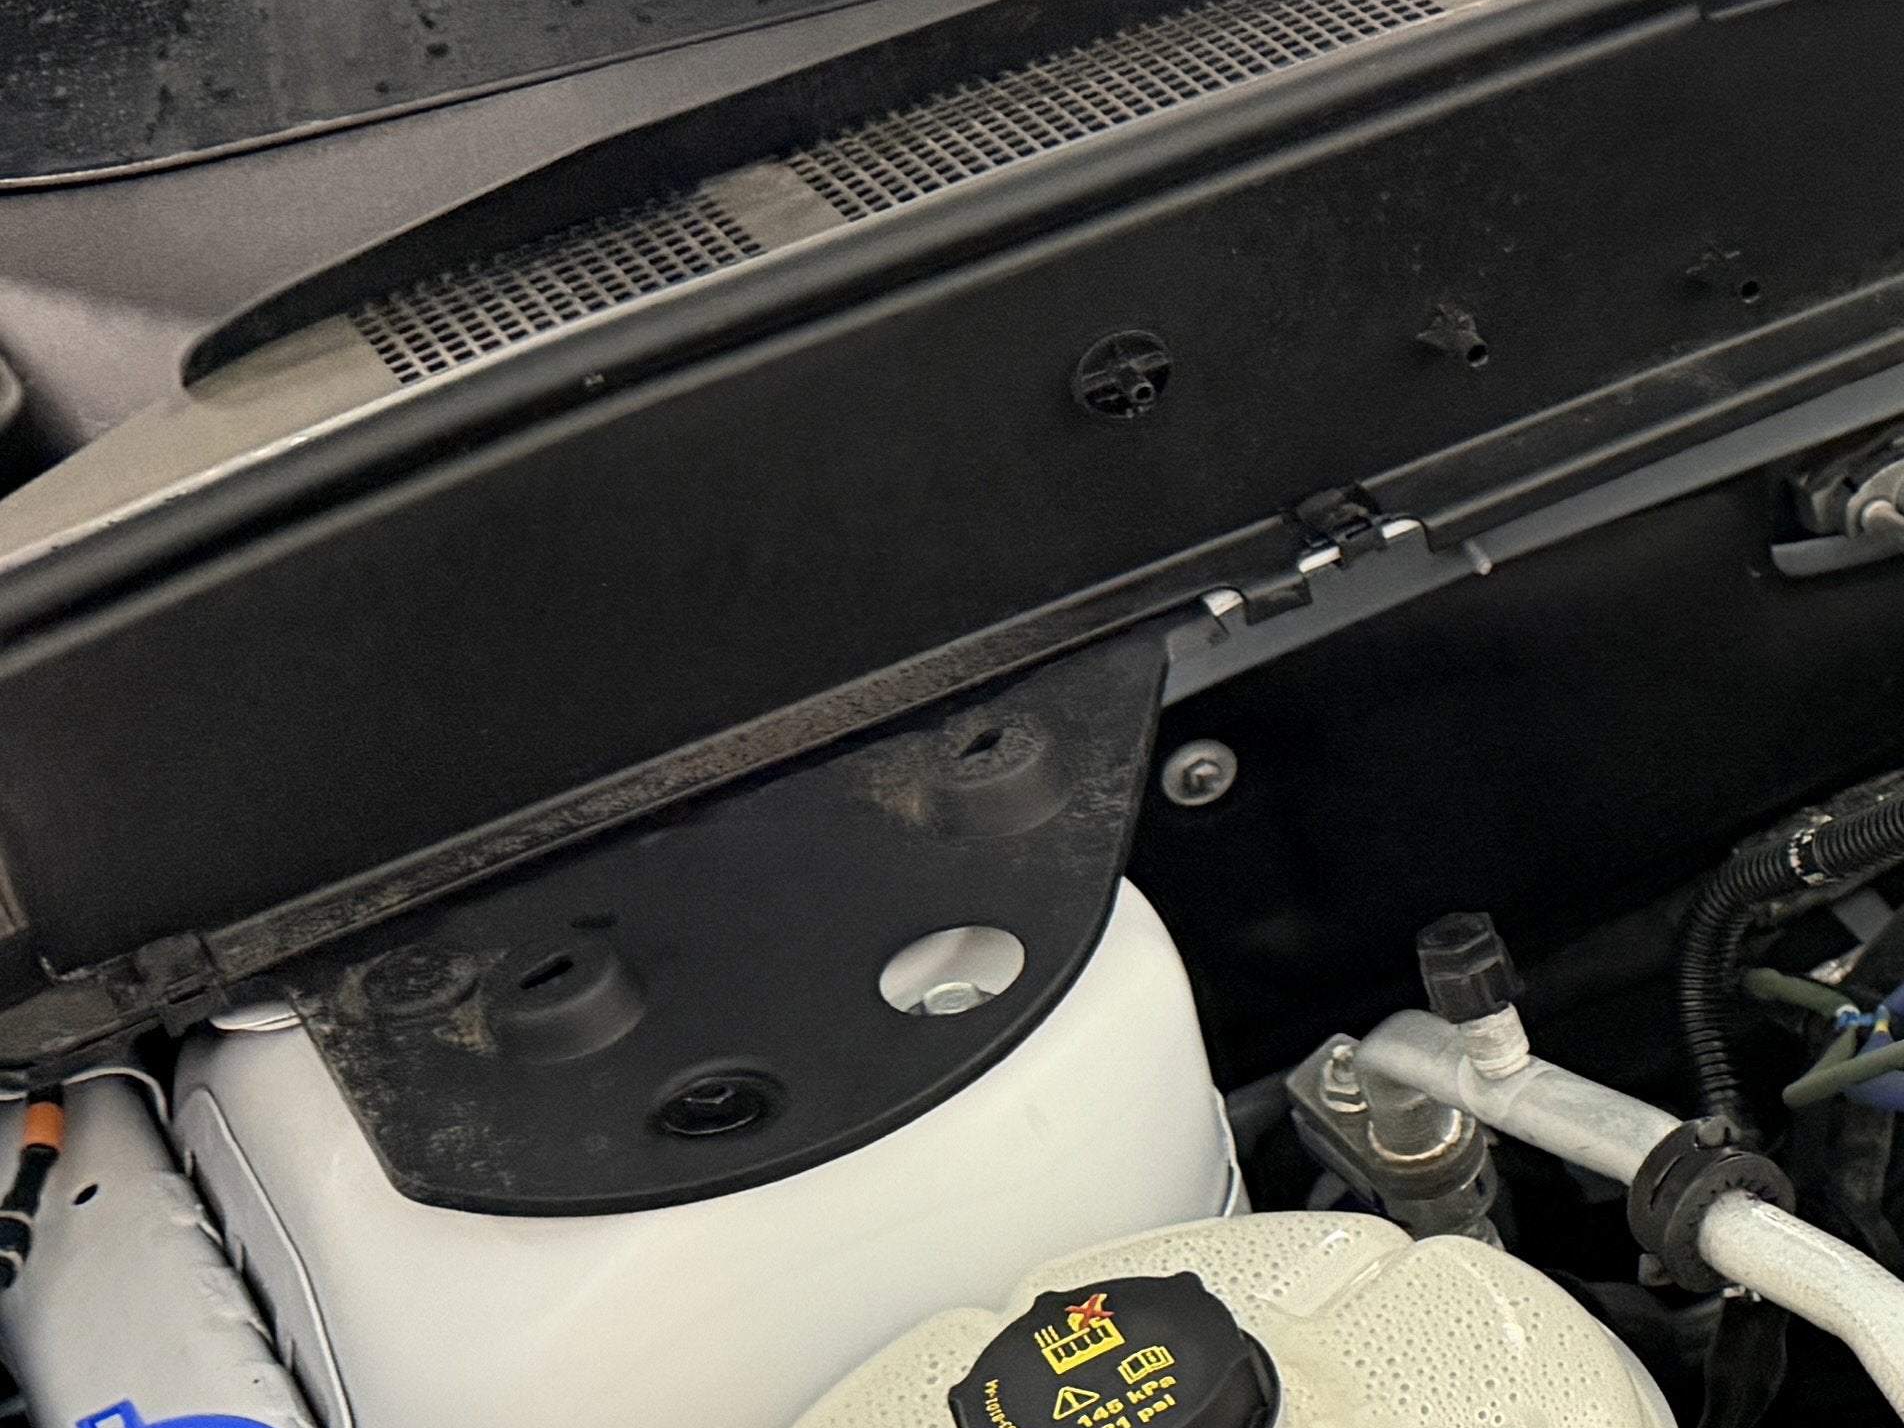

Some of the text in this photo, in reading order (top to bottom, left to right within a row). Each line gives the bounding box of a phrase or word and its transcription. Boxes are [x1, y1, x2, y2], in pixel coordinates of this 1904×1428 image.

[1077, 1375, 1177, 1428] 145 kPa
[1137, 1393, 1176, 1423] psi
